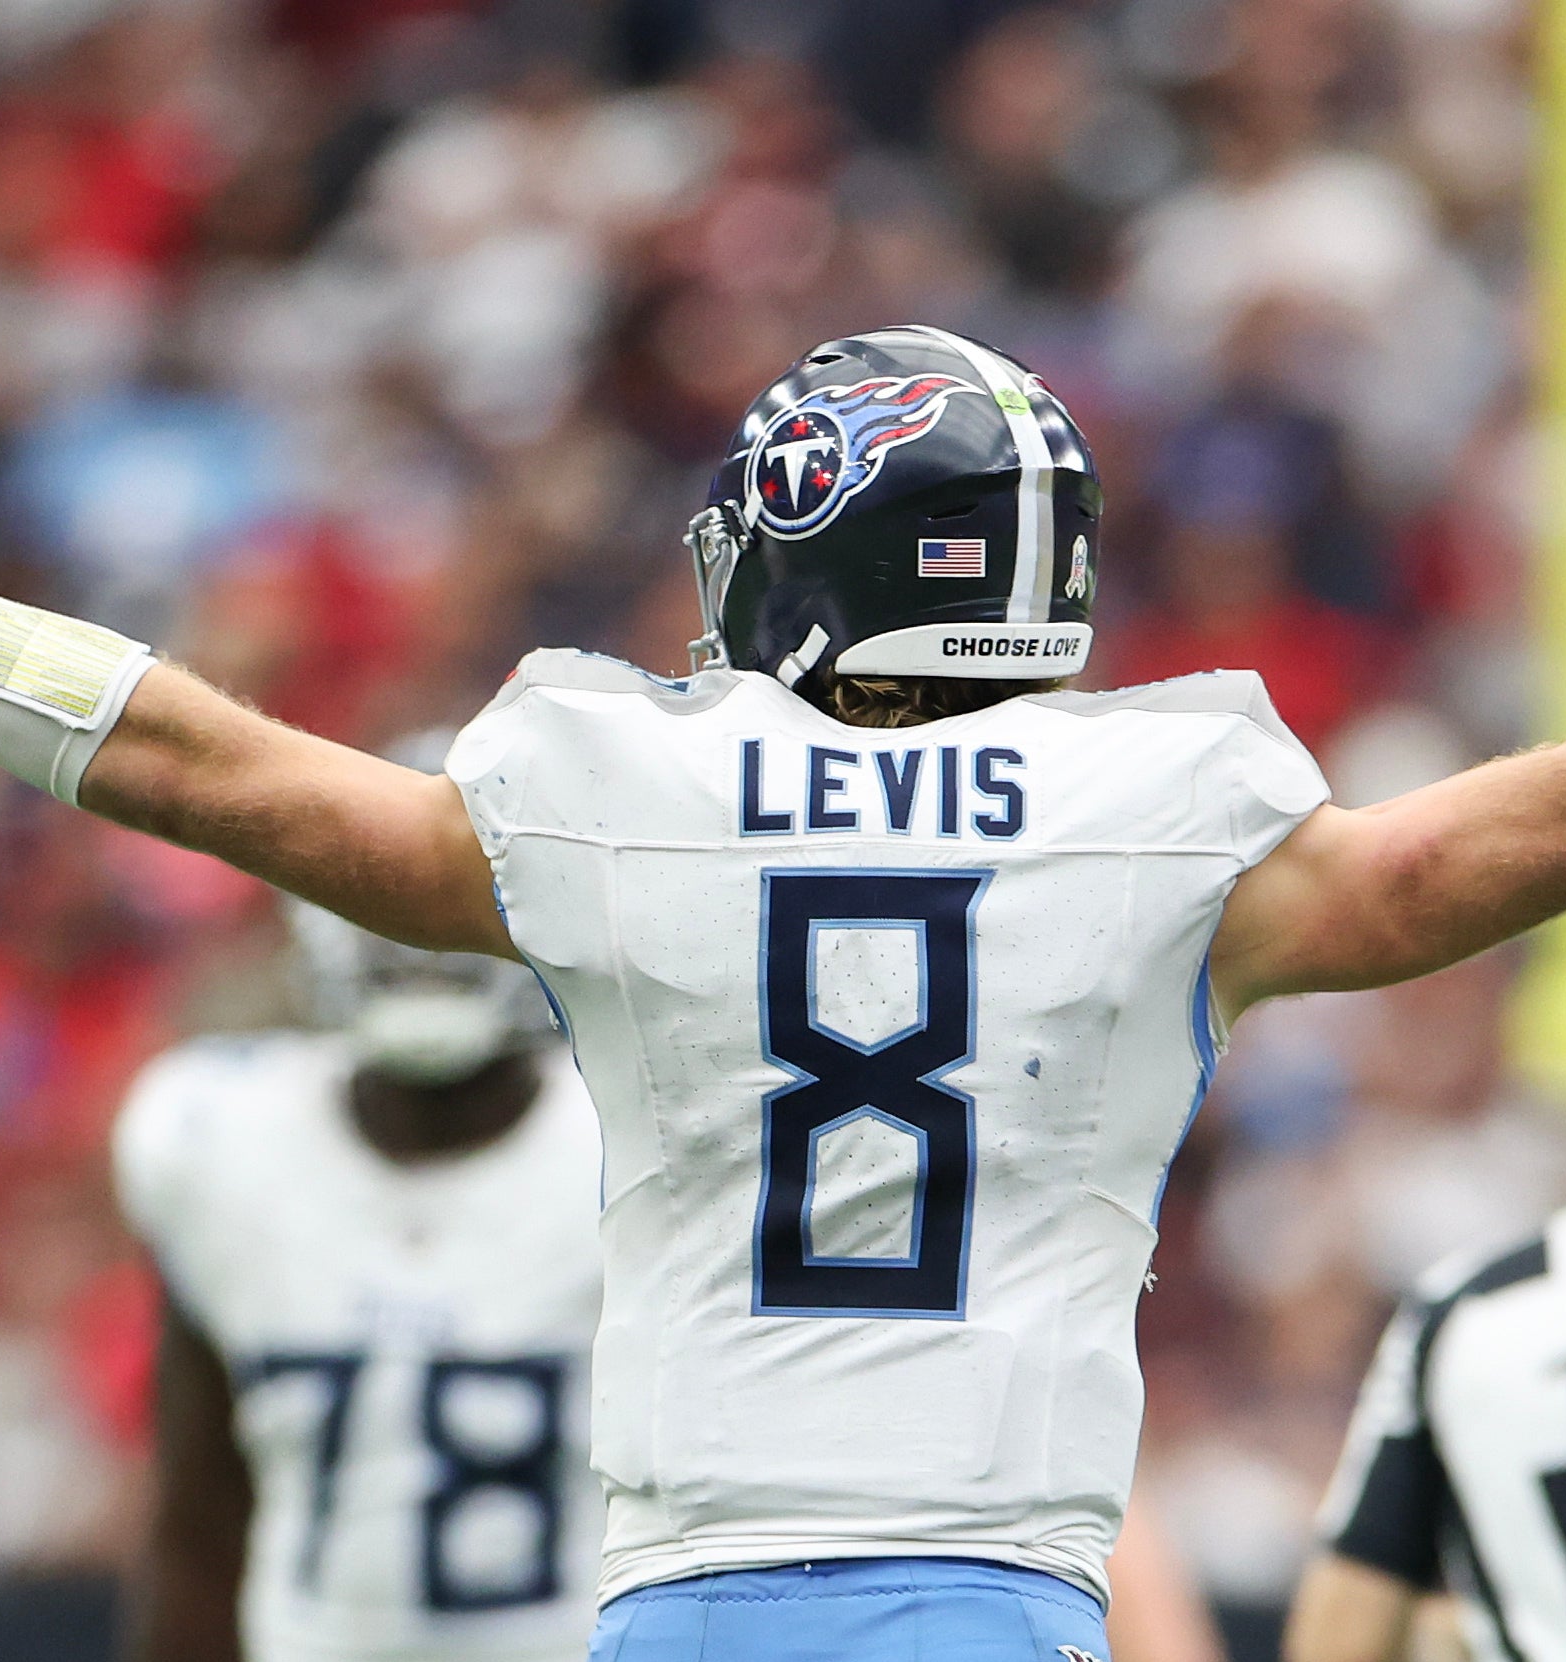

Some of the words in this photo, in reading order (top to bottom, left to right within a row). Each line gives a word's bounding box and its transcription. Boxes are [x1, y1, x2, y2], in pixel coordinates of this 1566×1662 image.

[942, 637, 1039, 657] CHOOSE
[1042, 637, 1081, 657] LOVE
[739, 739, 1027, 841] LEVIS
[752, 868, 996, 1320] 8
[240, 1351, 564, 1610] 78
